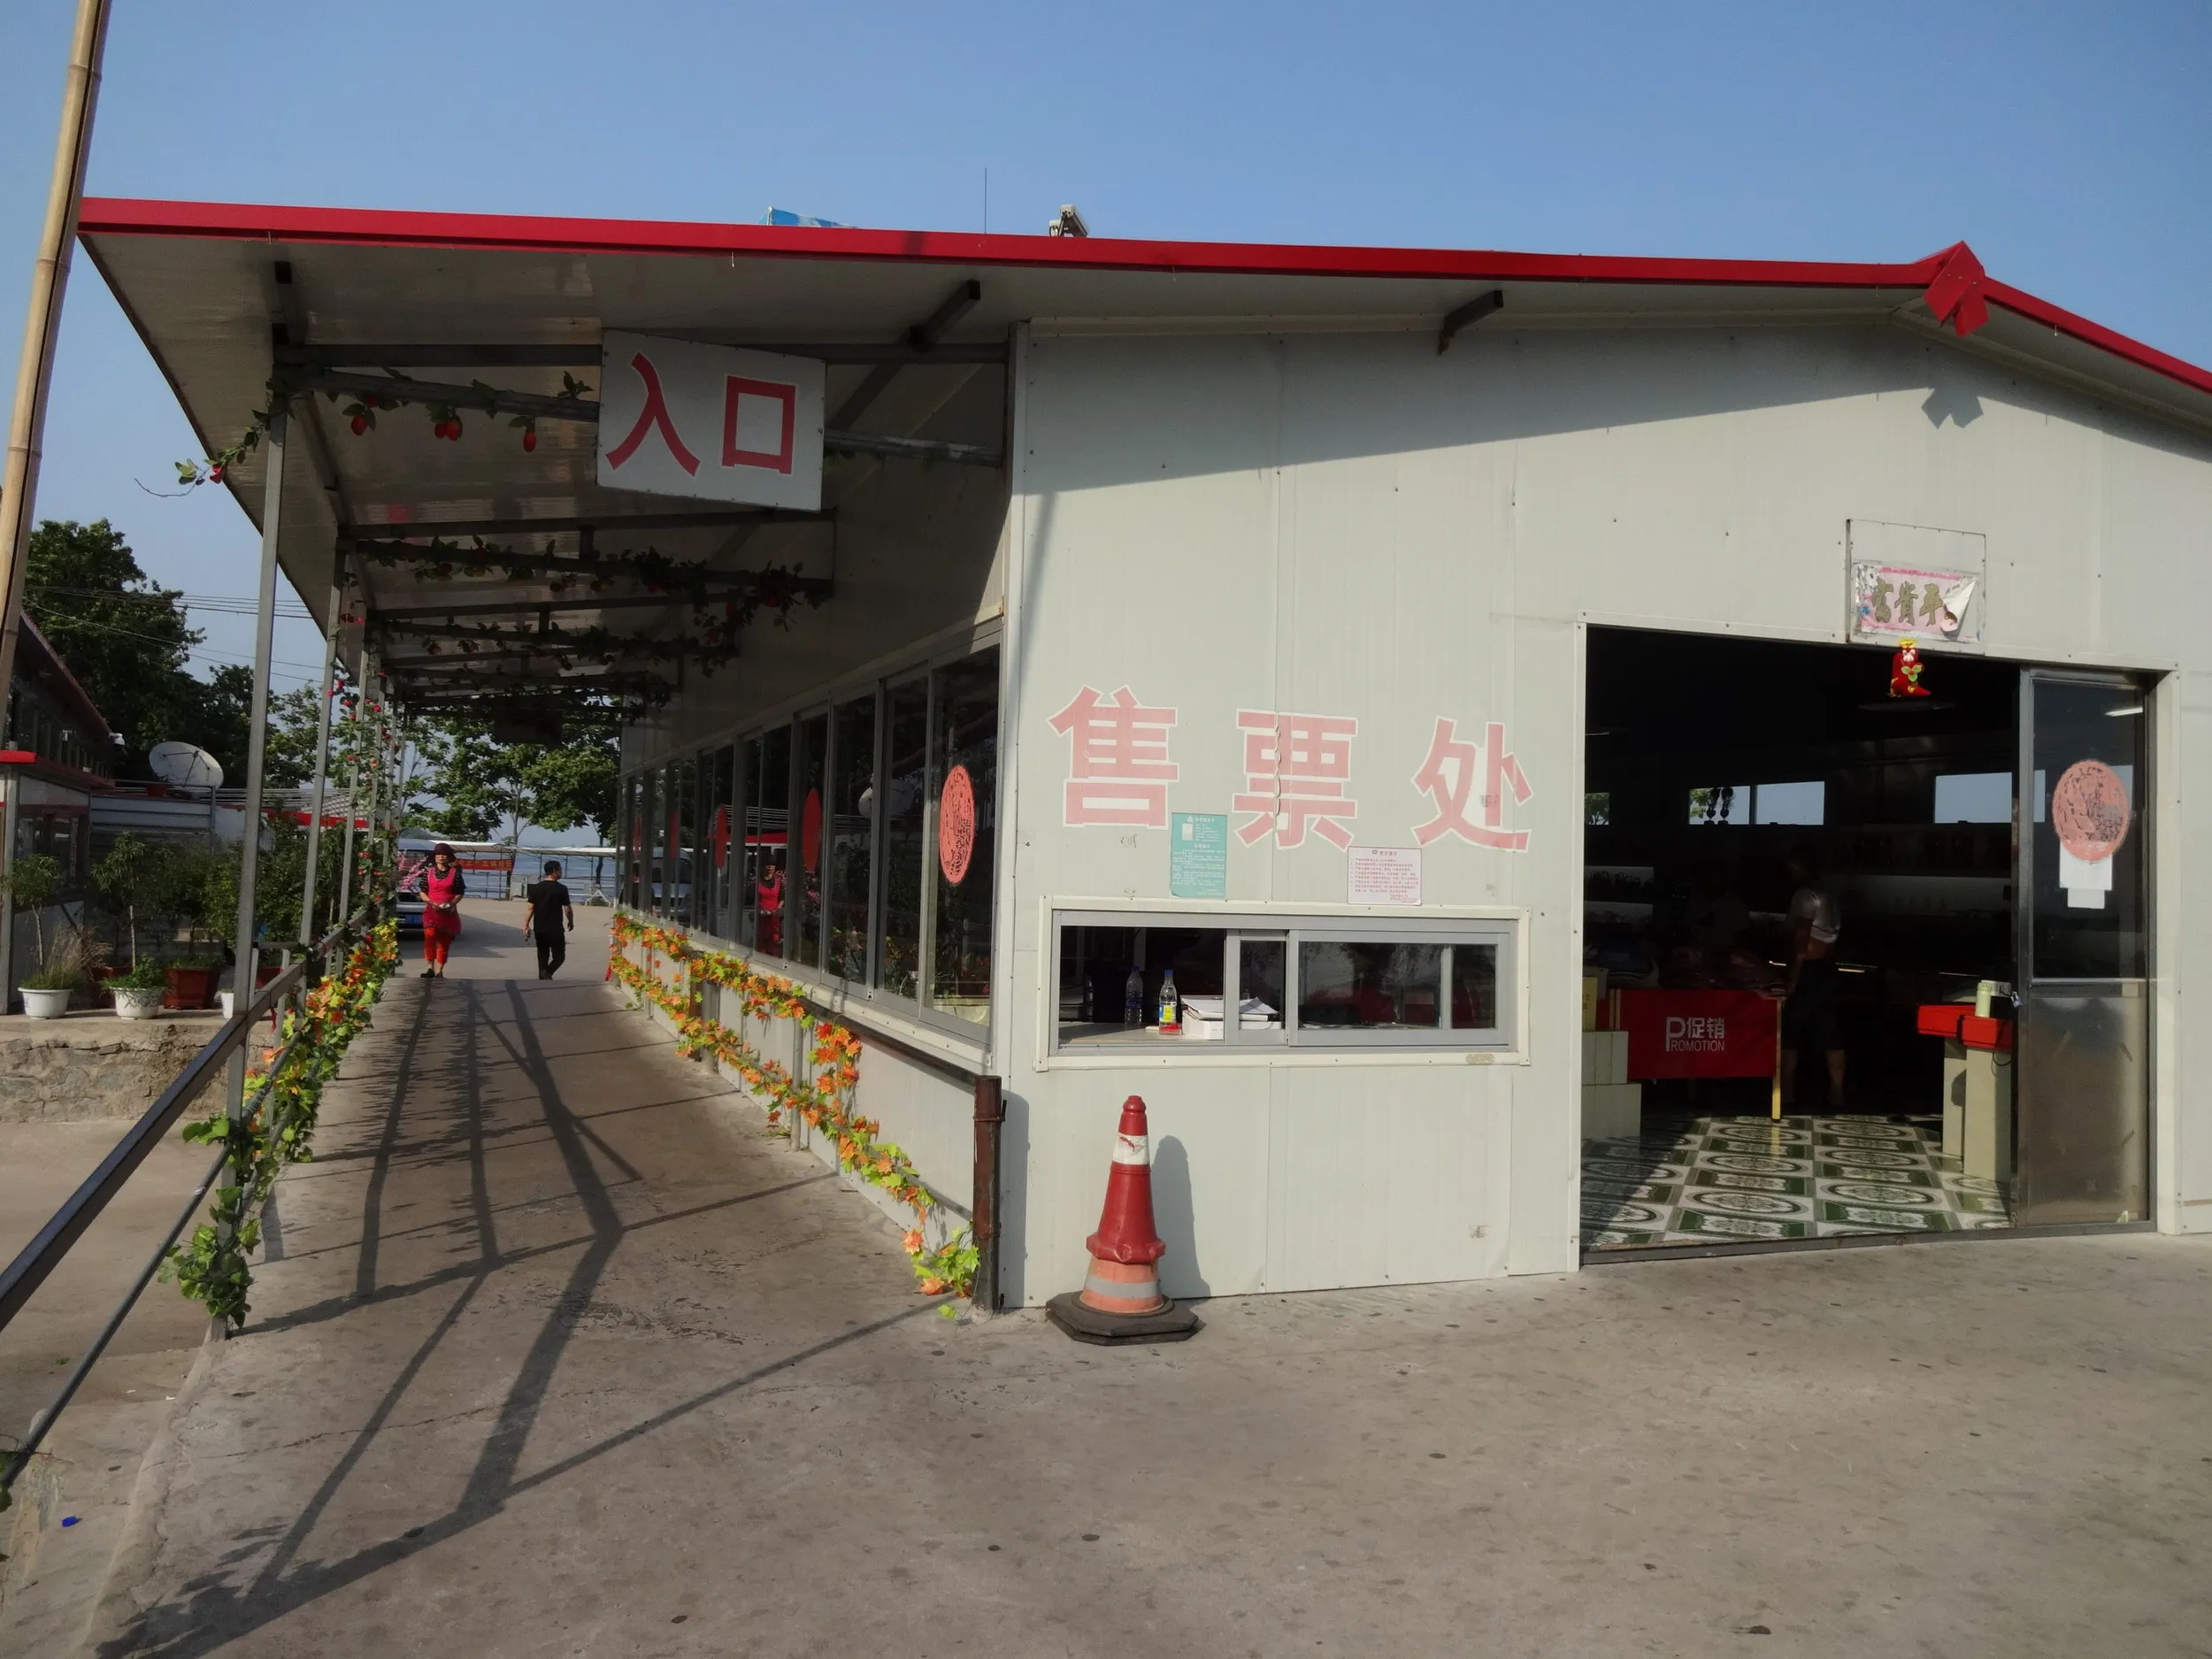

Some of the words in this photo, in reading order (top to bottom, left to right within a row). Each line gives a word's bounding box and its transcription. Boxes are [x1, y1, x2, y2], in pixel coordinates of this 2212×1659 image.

[605, 351, 796, 476] 入口
[1047, 684, 1532, 852] 售票处
[1666, 1018, 1724, 1051] PROMOTION
[1687, 1018, 1724, 1039] 促销
